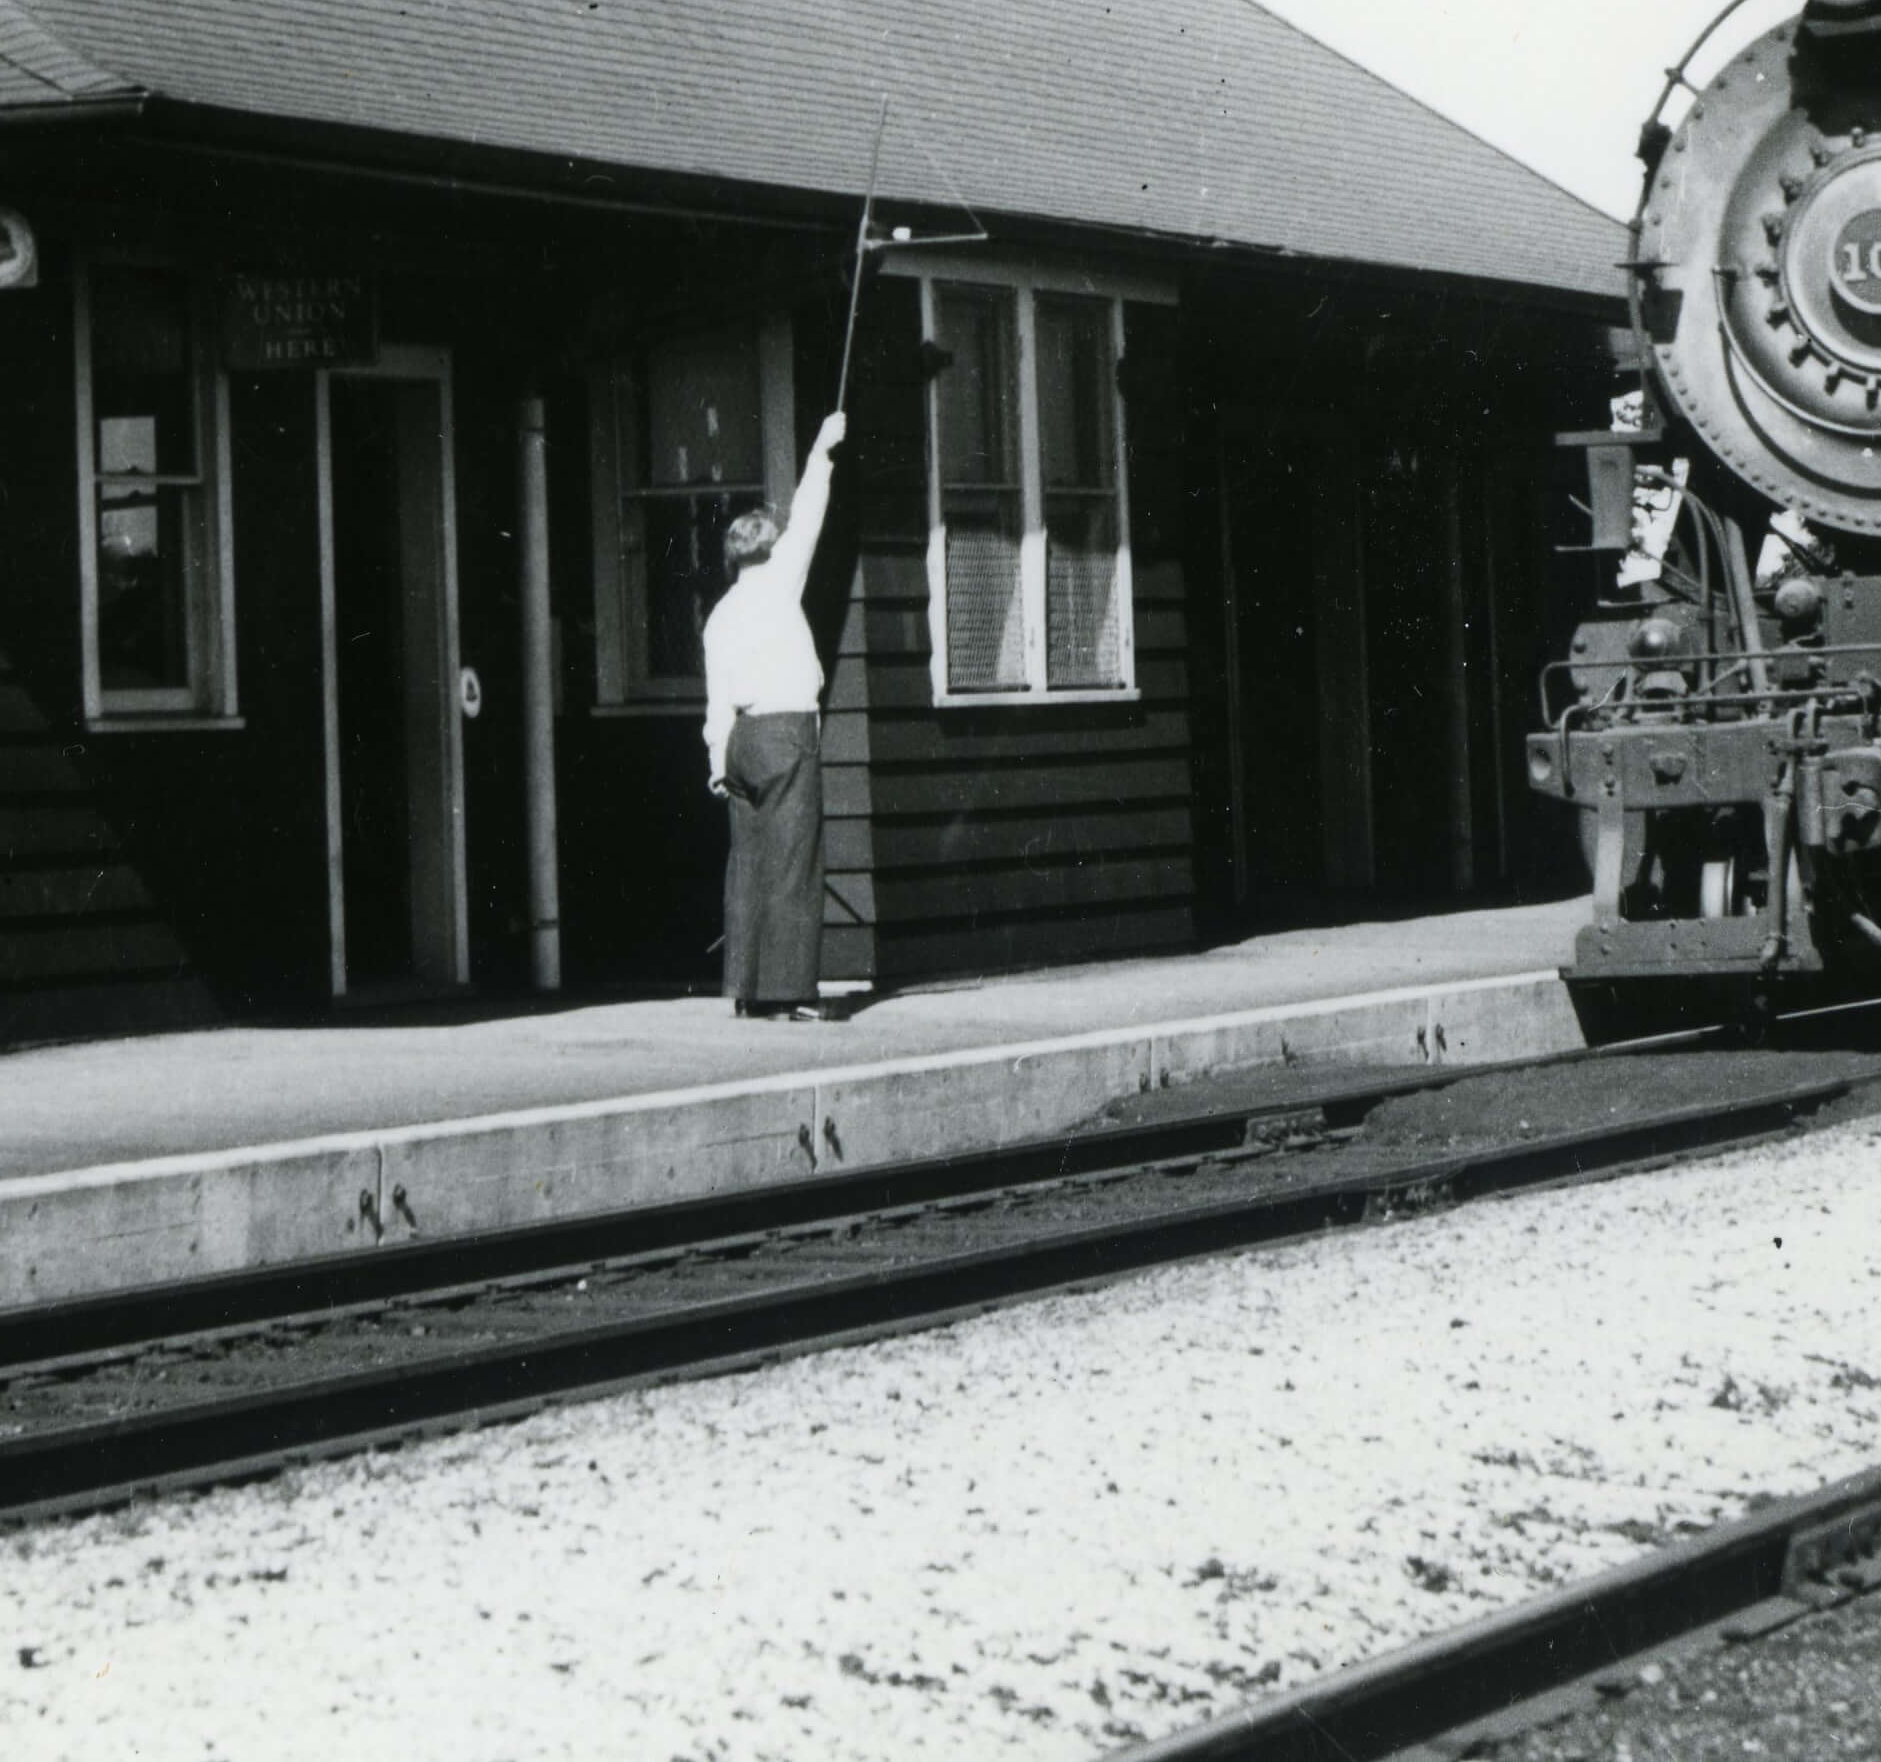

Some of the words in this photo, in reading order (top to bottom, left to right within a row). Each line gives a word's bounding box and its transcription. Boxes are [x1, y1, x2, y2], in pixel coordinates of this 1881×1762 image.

[236, 276, 361, 301] WESTERN
[252, 301, 346, 326] UNION
[265, 337, 336, 359] HERE
